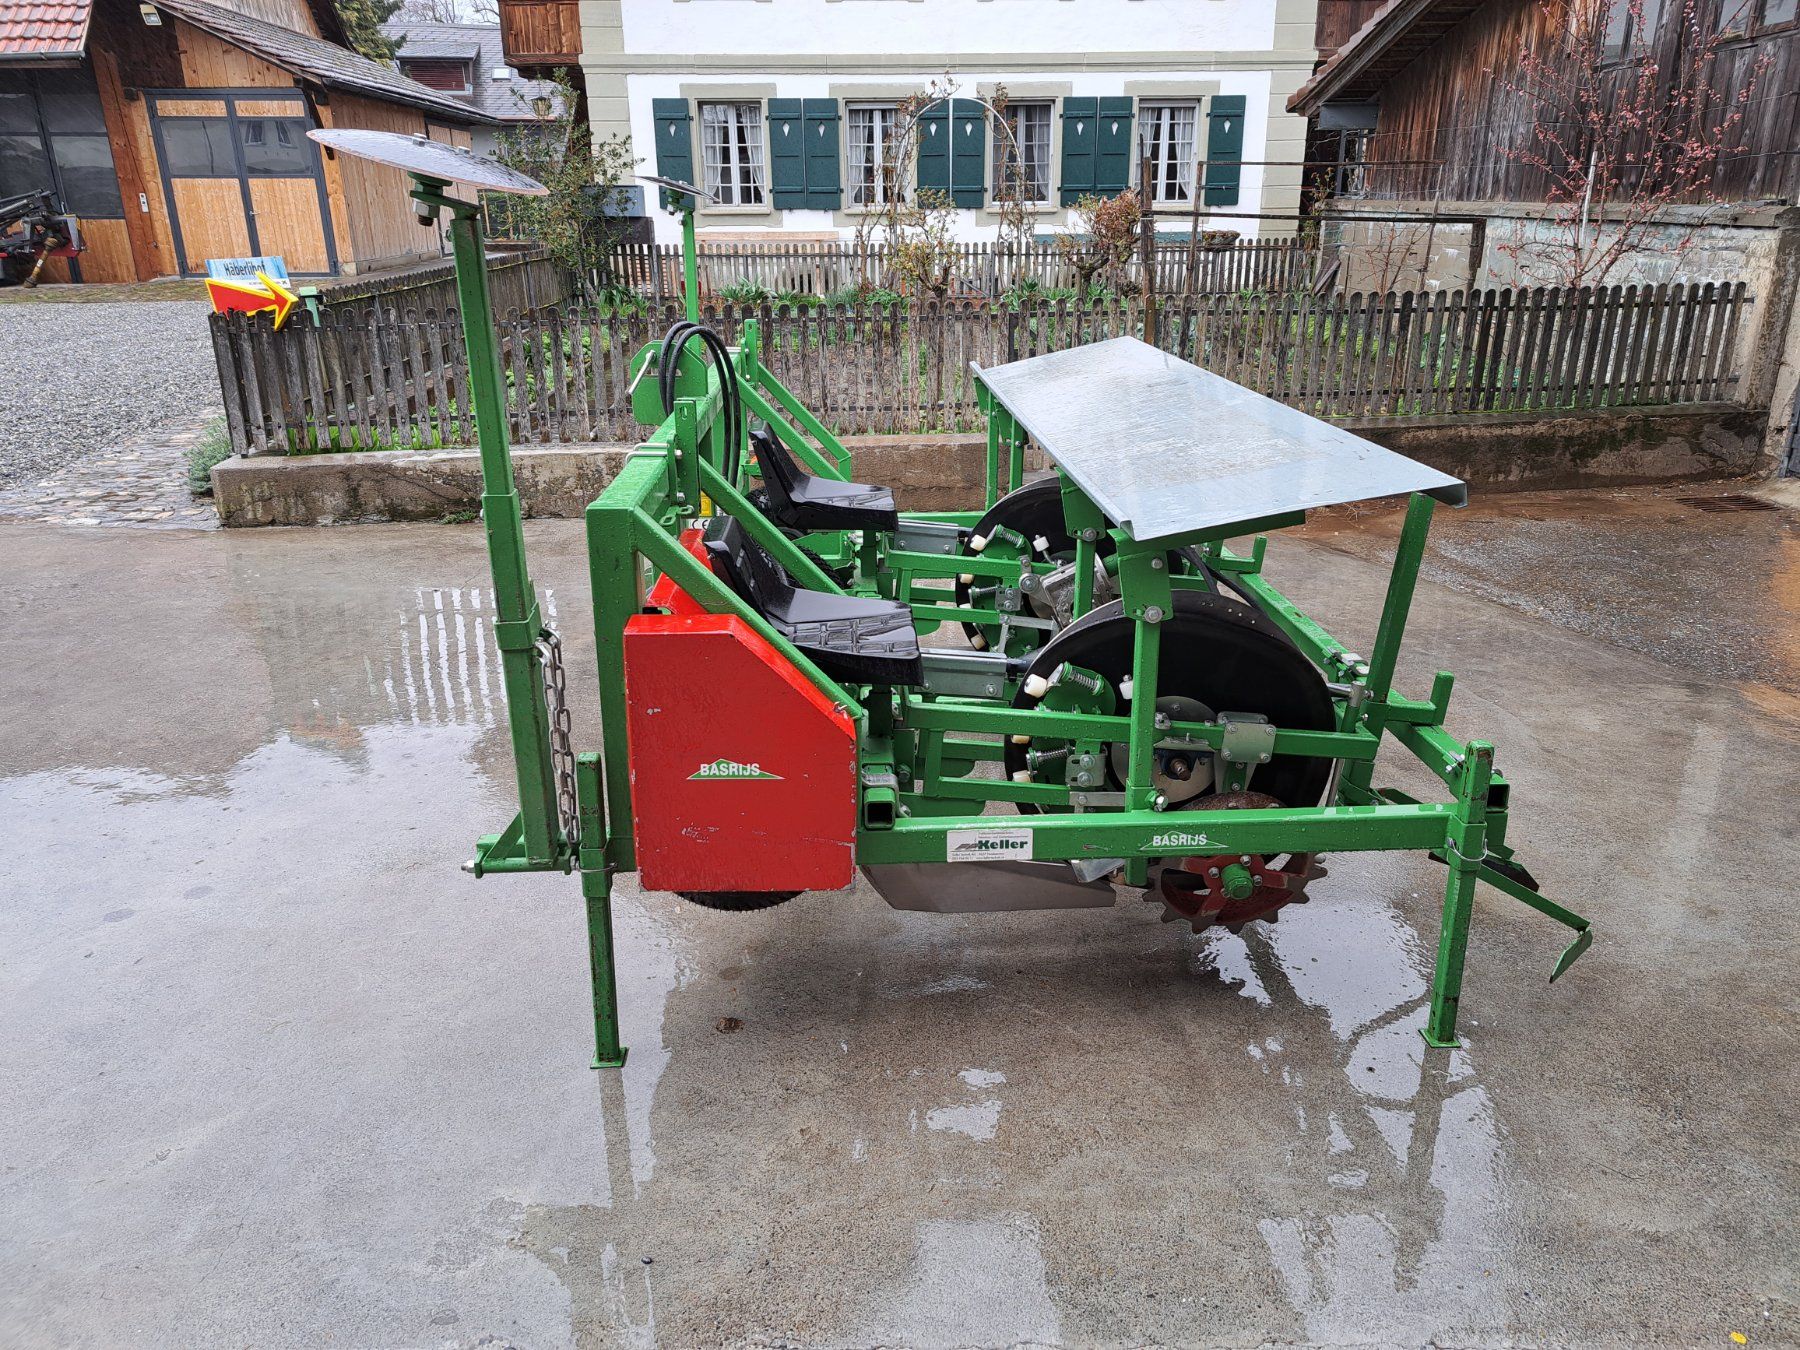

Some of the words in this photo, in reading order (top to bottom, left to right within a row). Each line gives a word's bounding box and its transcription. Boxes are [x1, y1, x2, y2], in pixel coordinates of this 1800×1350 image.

[700, 763, 760, 776] BASRIJS
[977, 839, 1028, 850] Keller
[1152, 834, 1207, 846] BASRIJS
